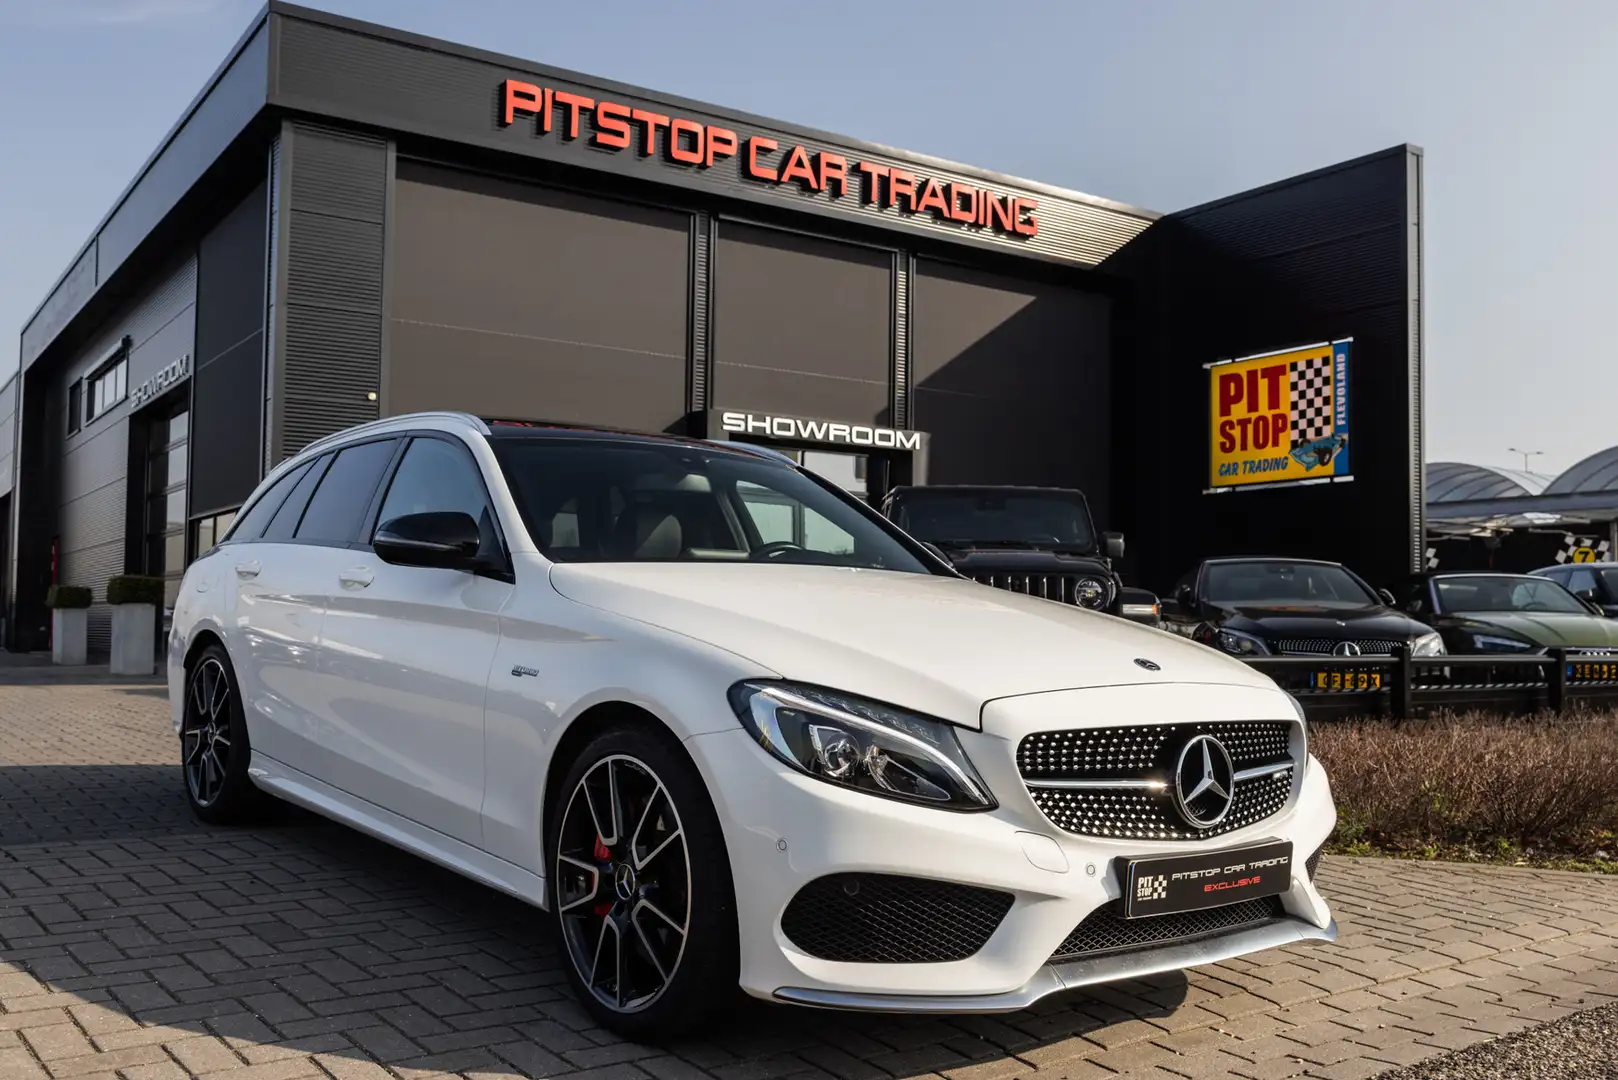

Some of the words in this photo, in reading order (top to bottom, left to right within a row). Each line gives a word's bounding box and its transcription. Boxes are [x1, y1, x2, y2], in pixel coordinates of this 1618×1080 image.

[505, 79, 738, 167] PITSTOP
[748, 135, 848, 196] CAR
[859, 160, 1039, 237] TRADING
[1219, 364, 1287, 417] PIT
[1336, 353, 1346, 426] FLEVOLAND
[722, 412, 920, 450] SHOWROOM
[1219, 413, 1288, 454] STOP
[1218, 462, 1239, 476] CAR
[1242, 456, 1289, 474] TRADING
[1578, 551, 1590, 563] 7
[1171, 868, 1221, 881] PITSTOP
[1223, 863, 1246, 874] CAR
[1248, 856, 1289, 870] TRADING
[1137, 887, 1153, 897] STOP
[1138, 876, 1154, 888] PIT
[1203, 876, 1260, 892] EXCLUSIVE
